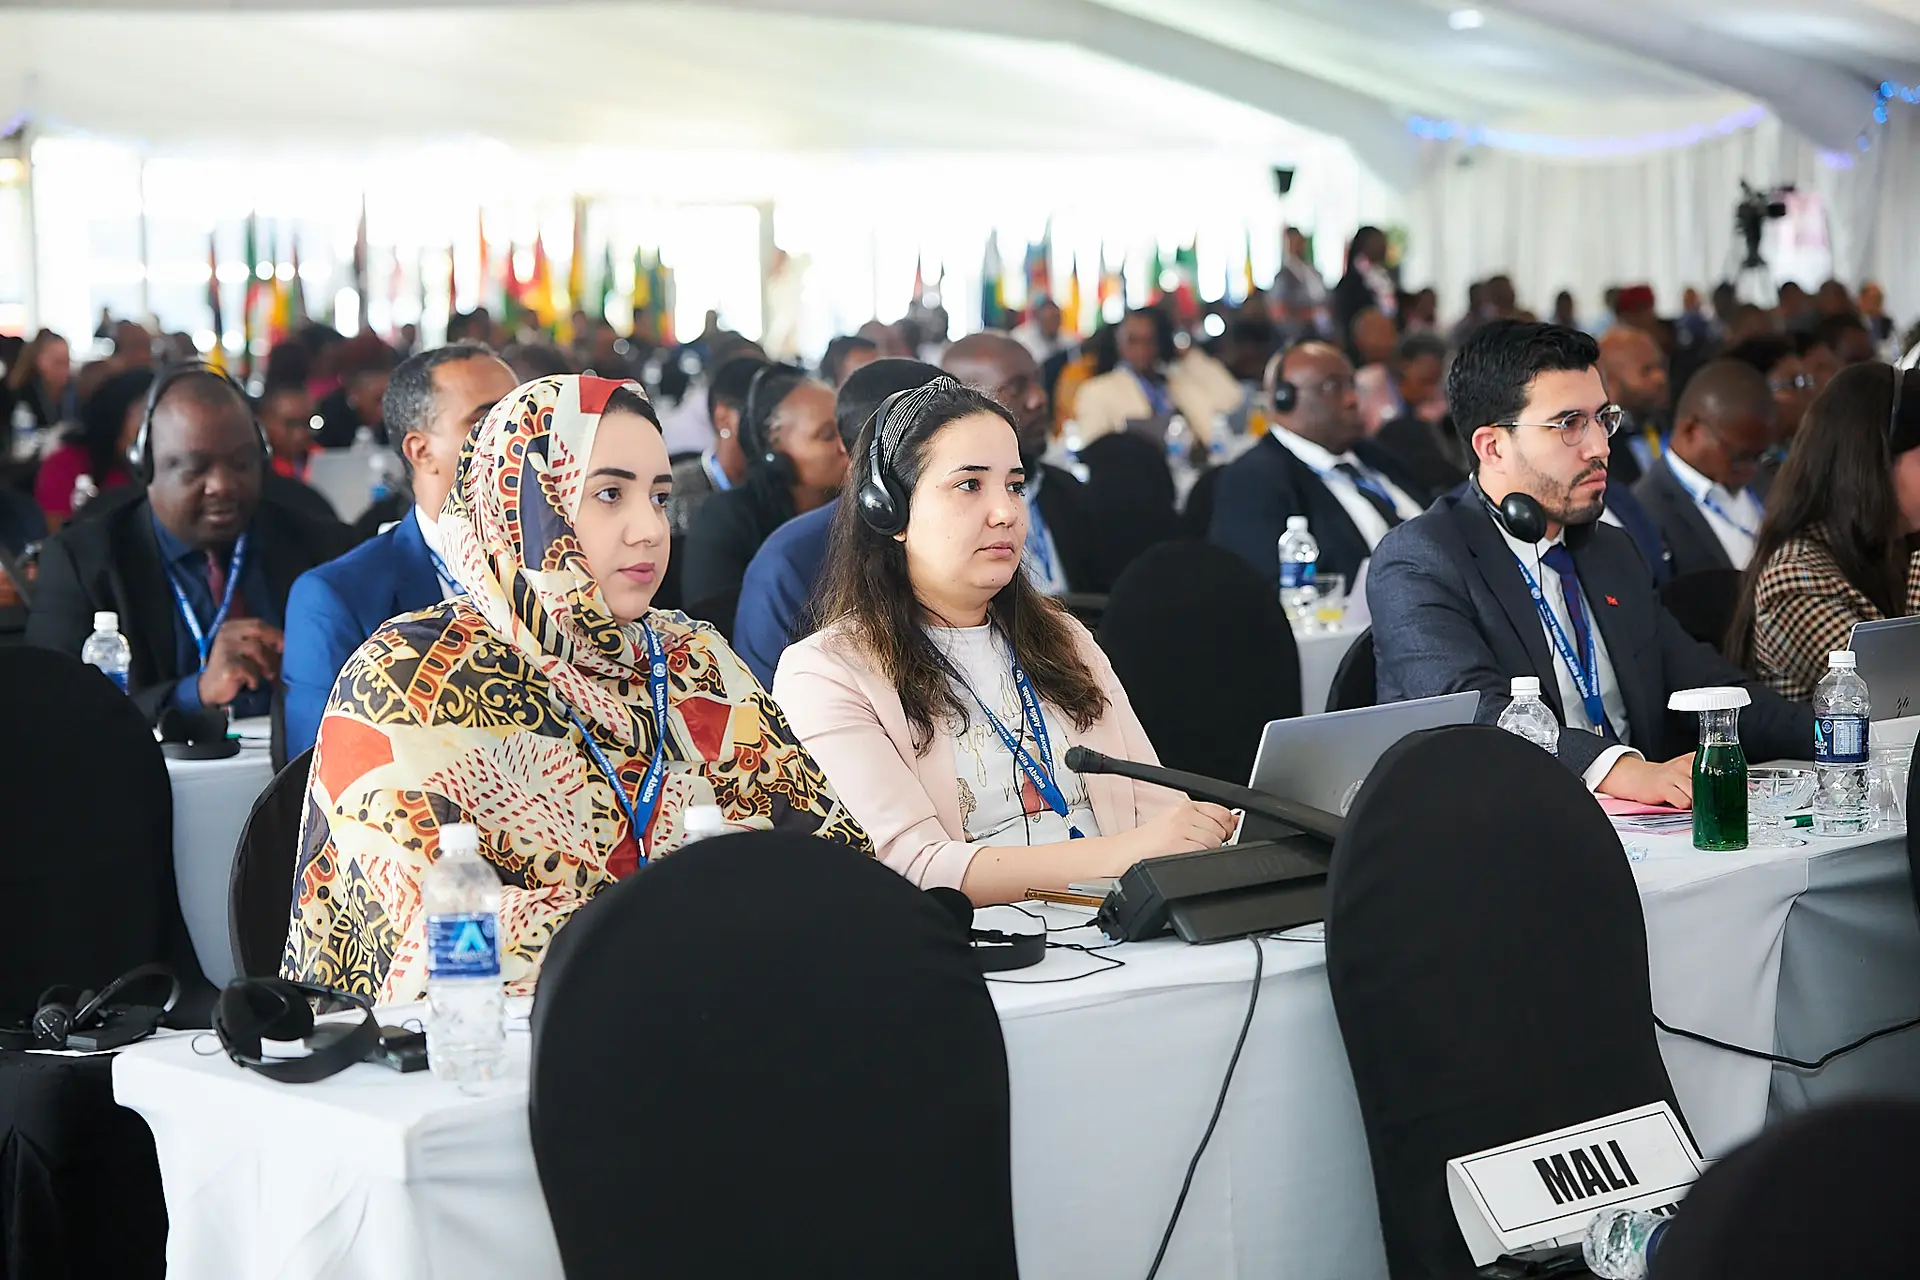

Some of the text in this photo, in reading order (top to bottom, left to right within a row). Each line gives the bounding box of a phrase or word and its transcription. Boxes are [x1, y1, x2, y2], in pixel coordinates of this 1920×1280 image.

[1551, 624, 1567, 652] Nations
[1565, 656, 1580, 677] Addis
[1575, 675, 1590, 699] Ababa
[655, 683, 665, 711] United
[1021, 685, 1035, 708] Ababa
[1029, 707, 1042, 729] Addis
[590, 742, 614, 775] Nations
[989, 712, 1011, 742] Nations
[1026, 766, 1047, 790] Ababa
[609, 774, 629, 804] United
[642, 775, 659, 804] Ababa
[1532, 1139, 1640, 1205] MALI
